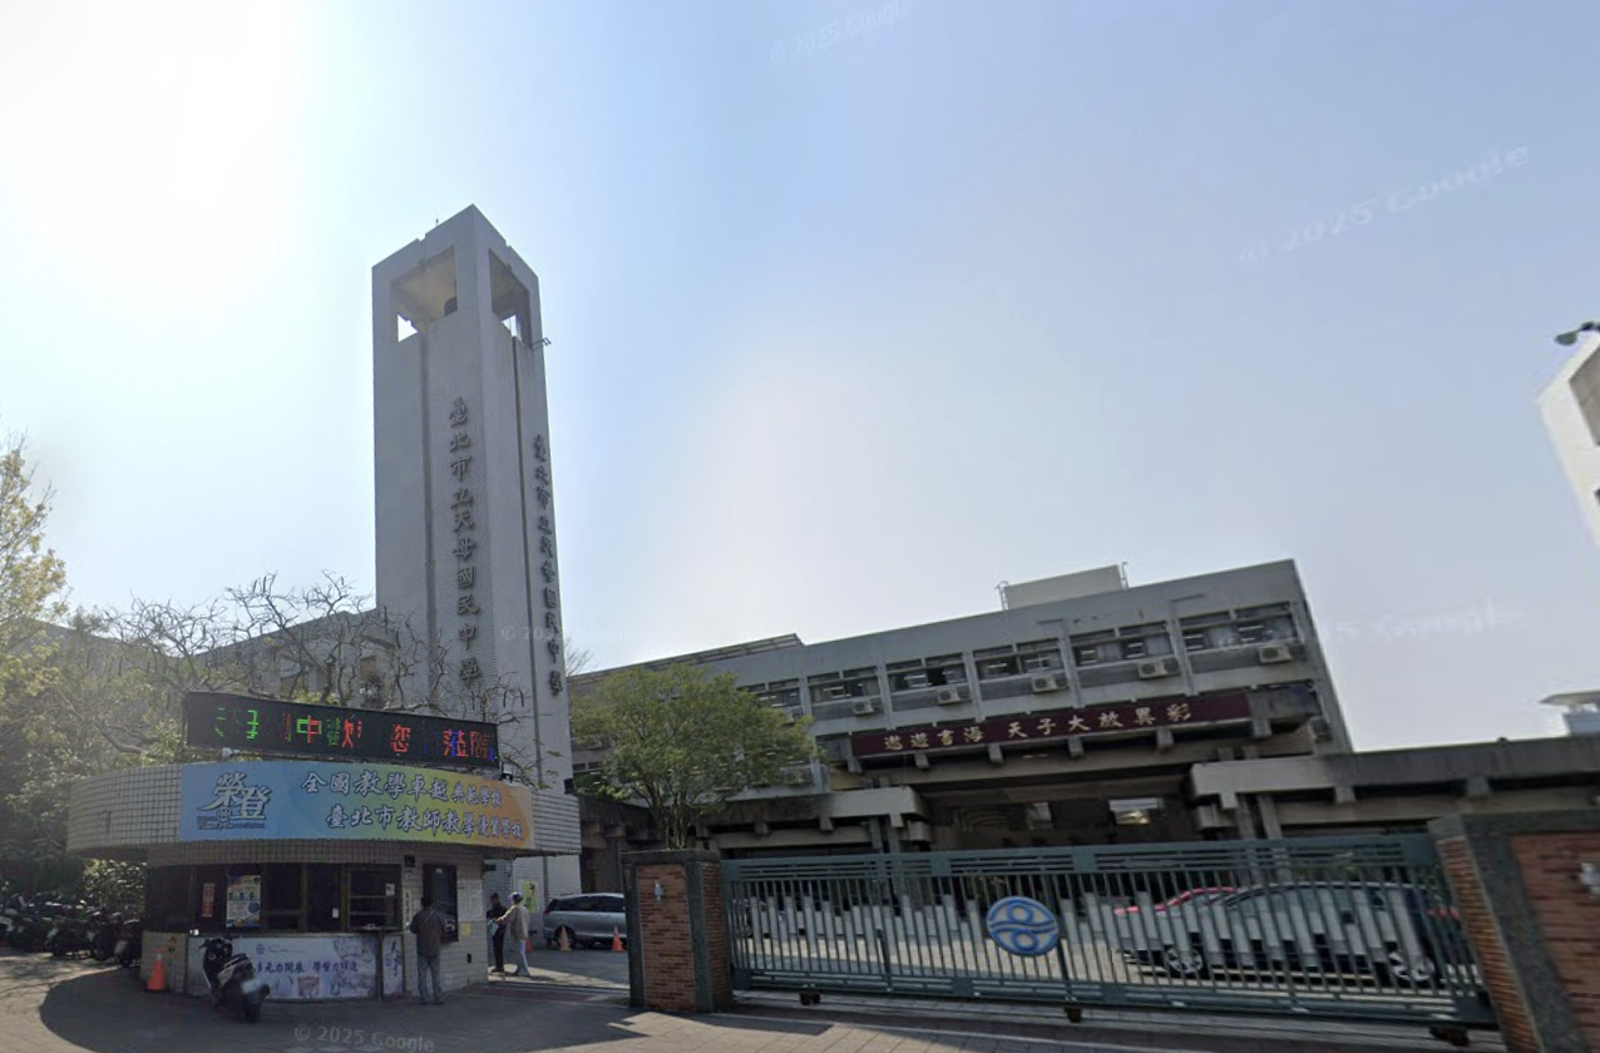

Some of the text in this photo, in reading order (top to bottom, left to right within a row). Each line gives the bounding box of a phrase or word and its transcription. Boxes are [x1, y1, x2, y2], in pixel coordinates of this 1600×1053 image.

[449, 396, 482, 683] 臺北市立天母國民中學
[199, 771, 271, 821] 榮登
